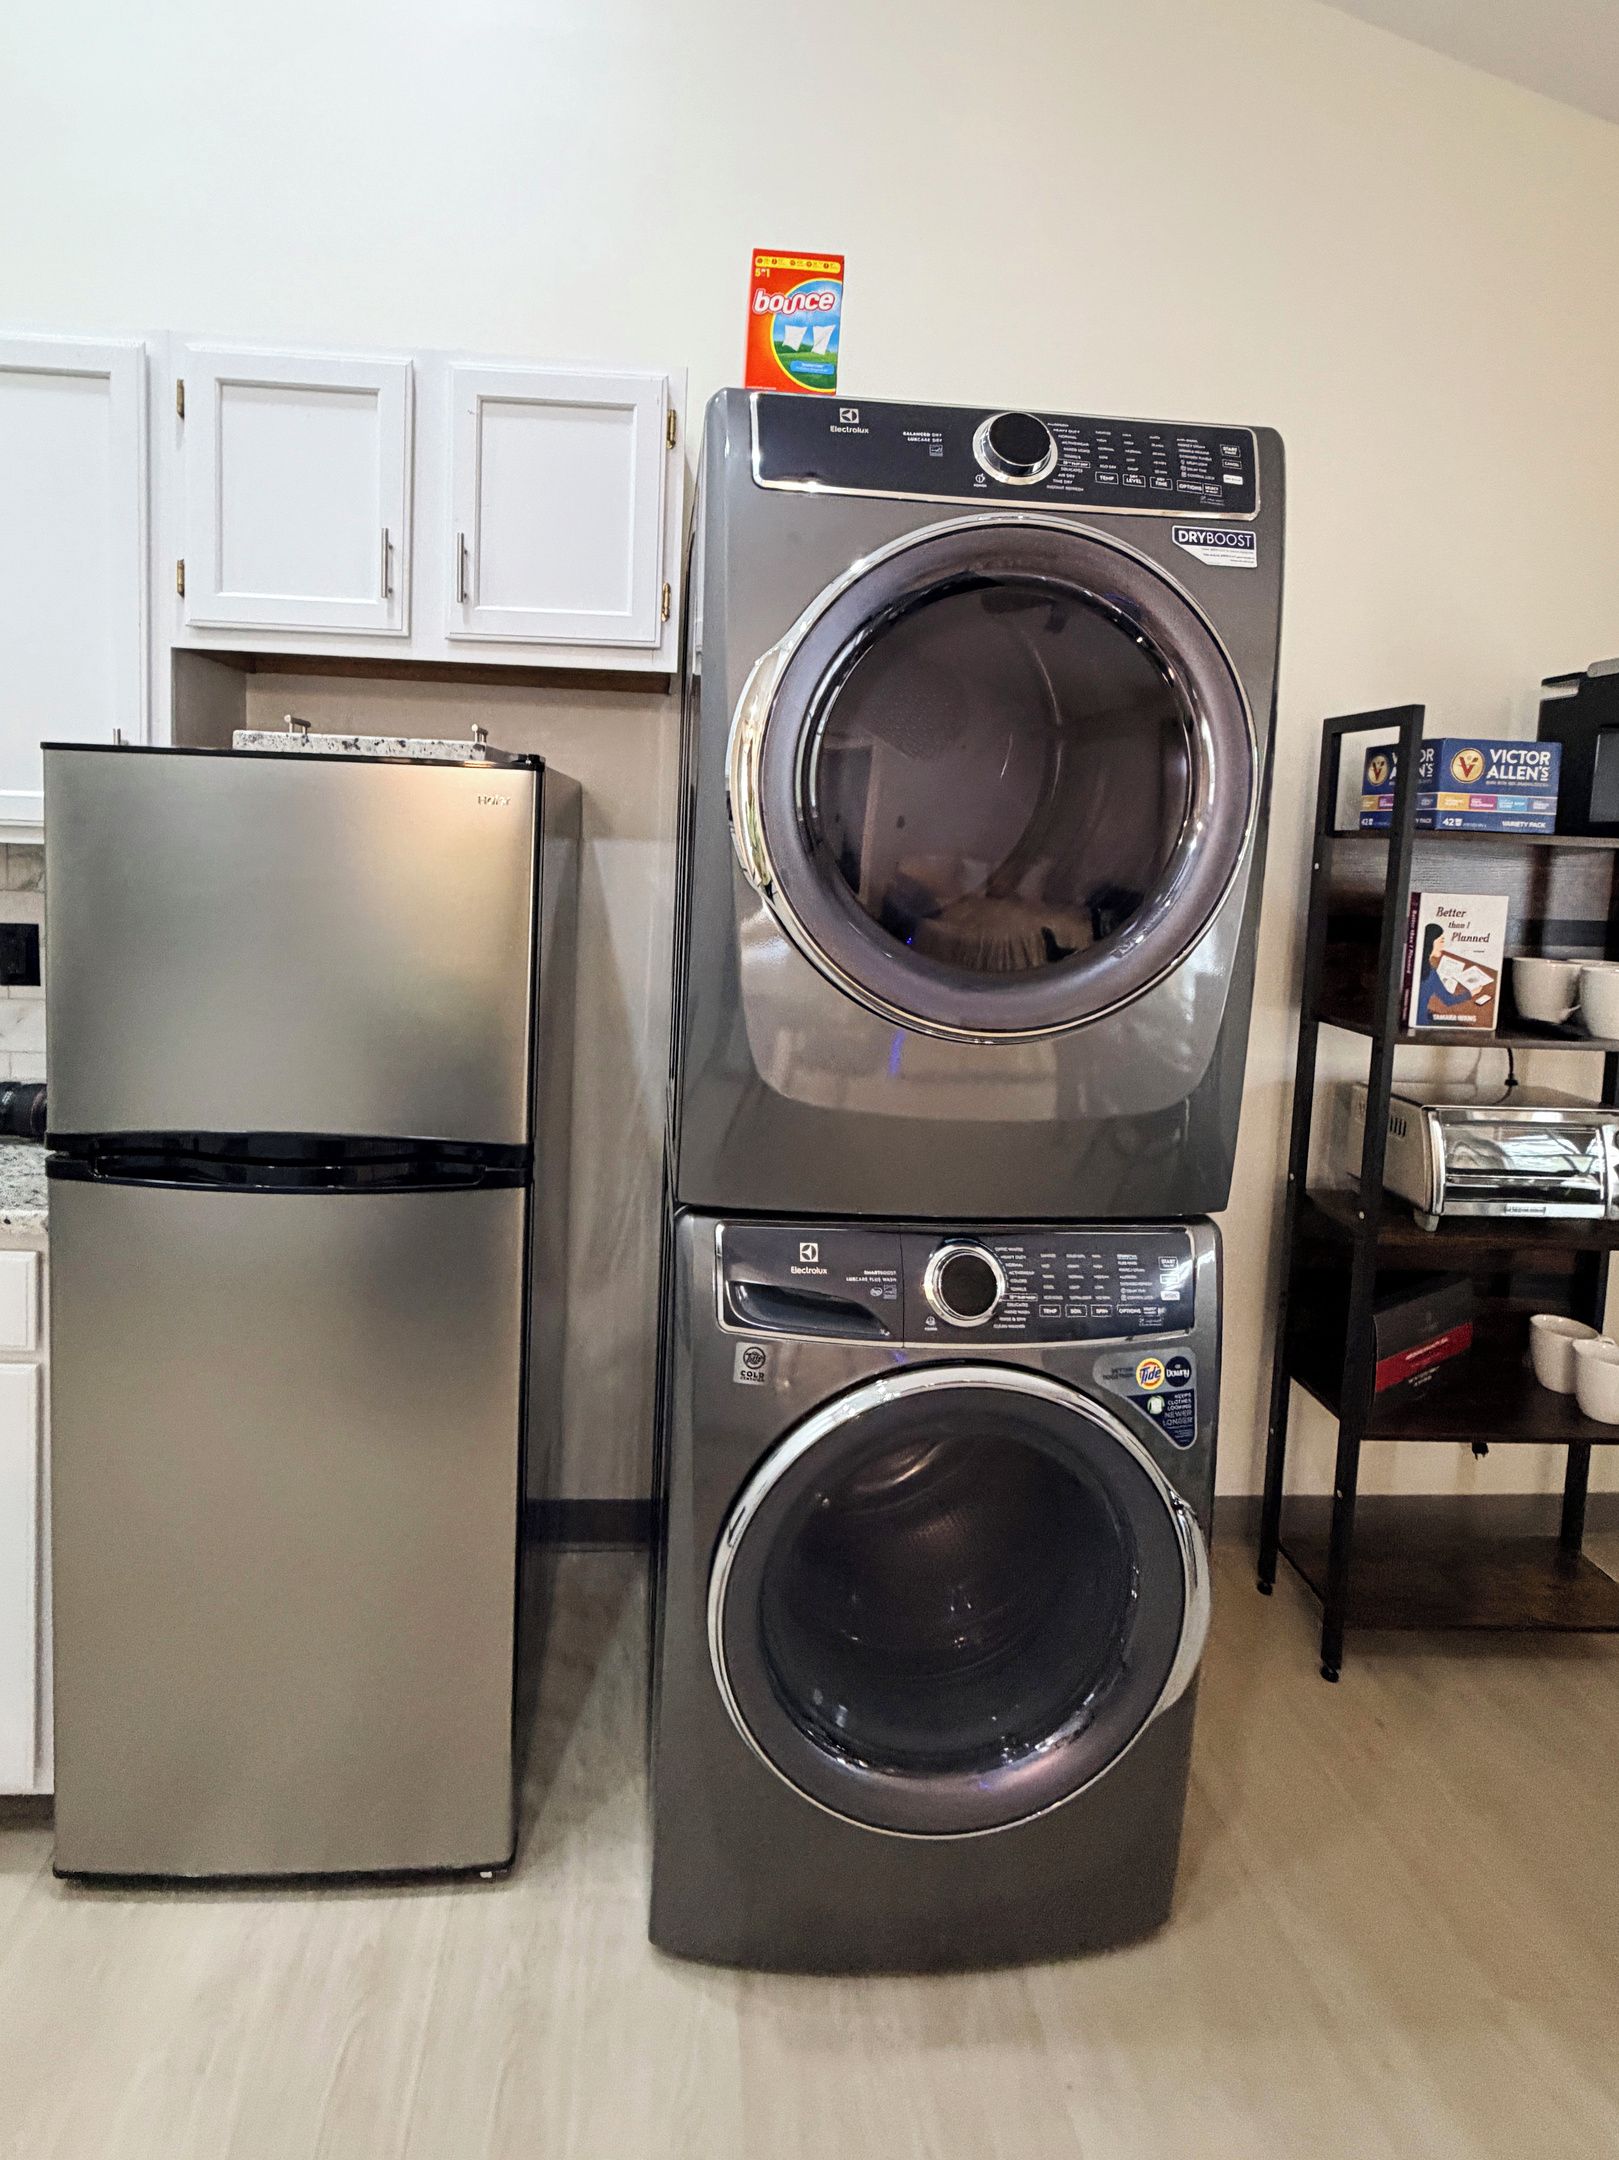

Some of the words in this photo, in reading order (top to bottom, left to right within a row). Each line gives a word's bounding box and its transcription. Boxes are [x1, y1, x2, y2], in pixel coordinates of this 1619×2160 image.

[753, 289, 836, 316] bounce
[830, 425, 869, 434] Electrolux
[1178, 530, 1252, 547] DRYBOOST
[1489, 749, 1551, 766] VICTOR
[1486, 764, 1550, 781] ALLEN'S
[1502, 820, 1528, 828] VARIETY
[1529, 821, 1547, 829] PACK
[1436, 907, 1467, 918] Better
[1448, 921, 1466, 929] than
[1451, 933, 1491, 943] Planned
[790, 1266, 828, 1275] Electrolux
[1140, 1365, 1161, 1385] Tide
[1166, 1369, 1190, 1378] Downy
